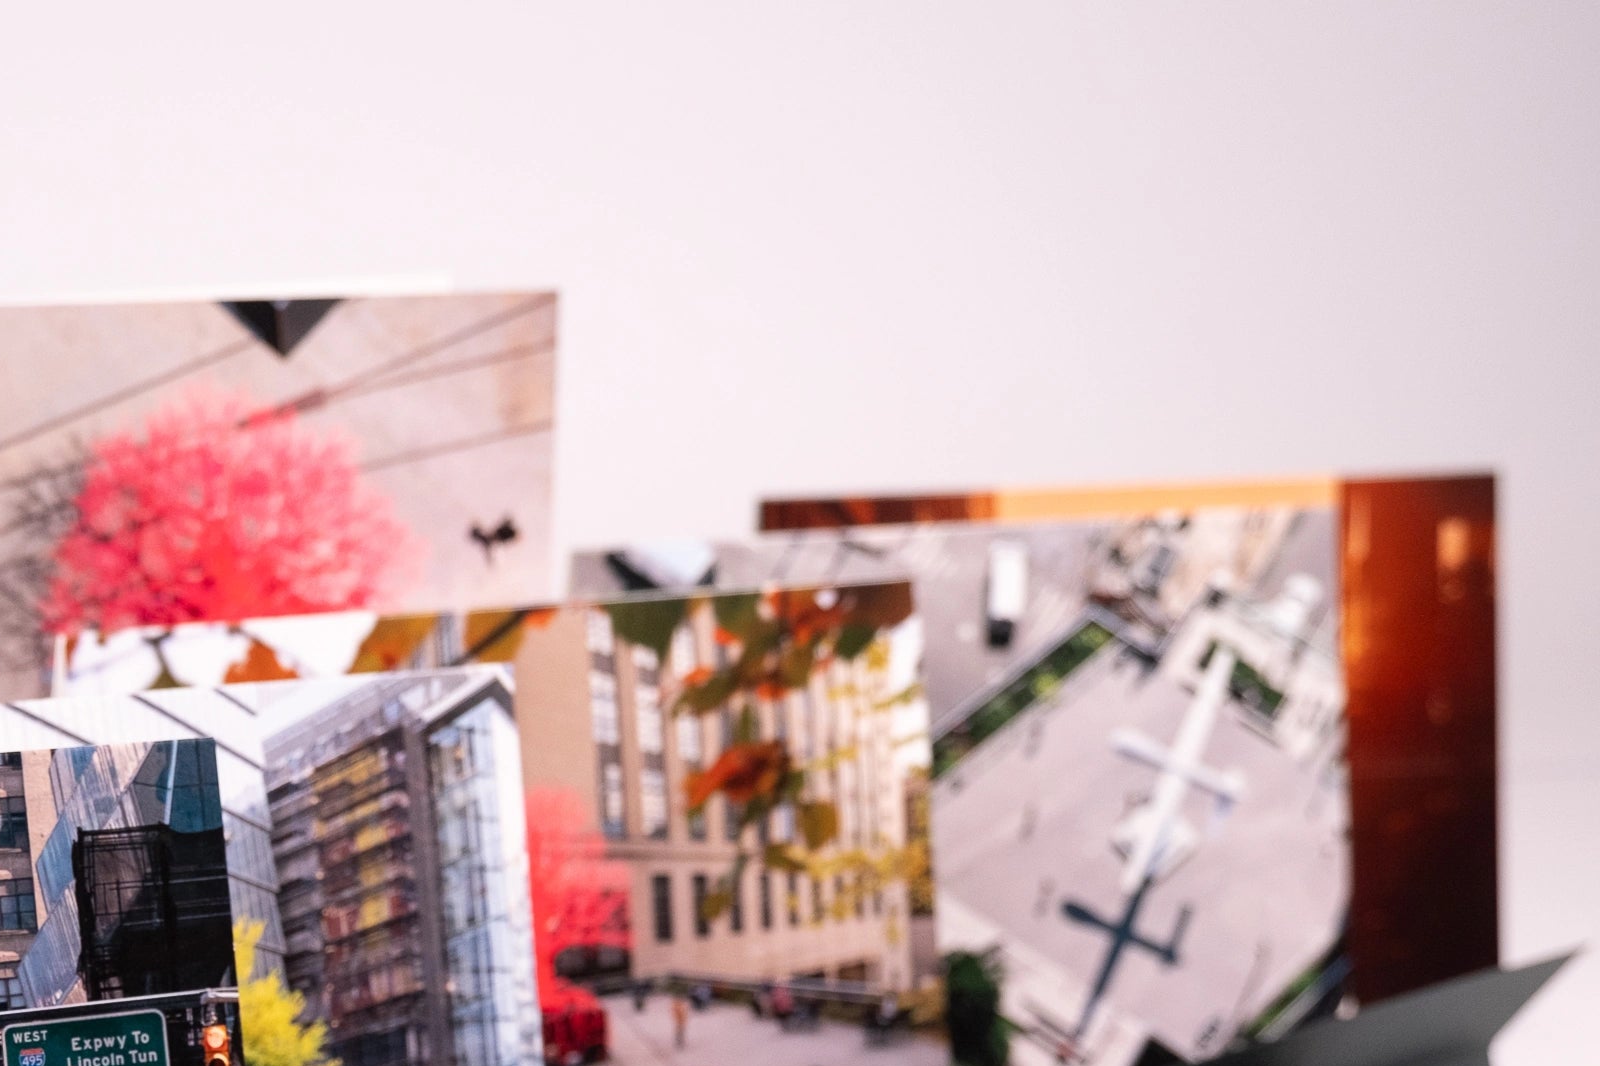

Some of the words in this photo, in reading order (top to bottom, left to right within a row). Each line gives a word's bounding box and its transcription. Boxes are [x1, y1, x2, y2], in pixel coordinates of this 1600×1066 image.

[12, 1030, 48, 1044] WEST
[71, 1035, 127, 1052] Expwy
[131, 1030, 150, 1044] To
[22, 1055, 43, 1066] 495
[128, 1049, 158, 1064] Tun
